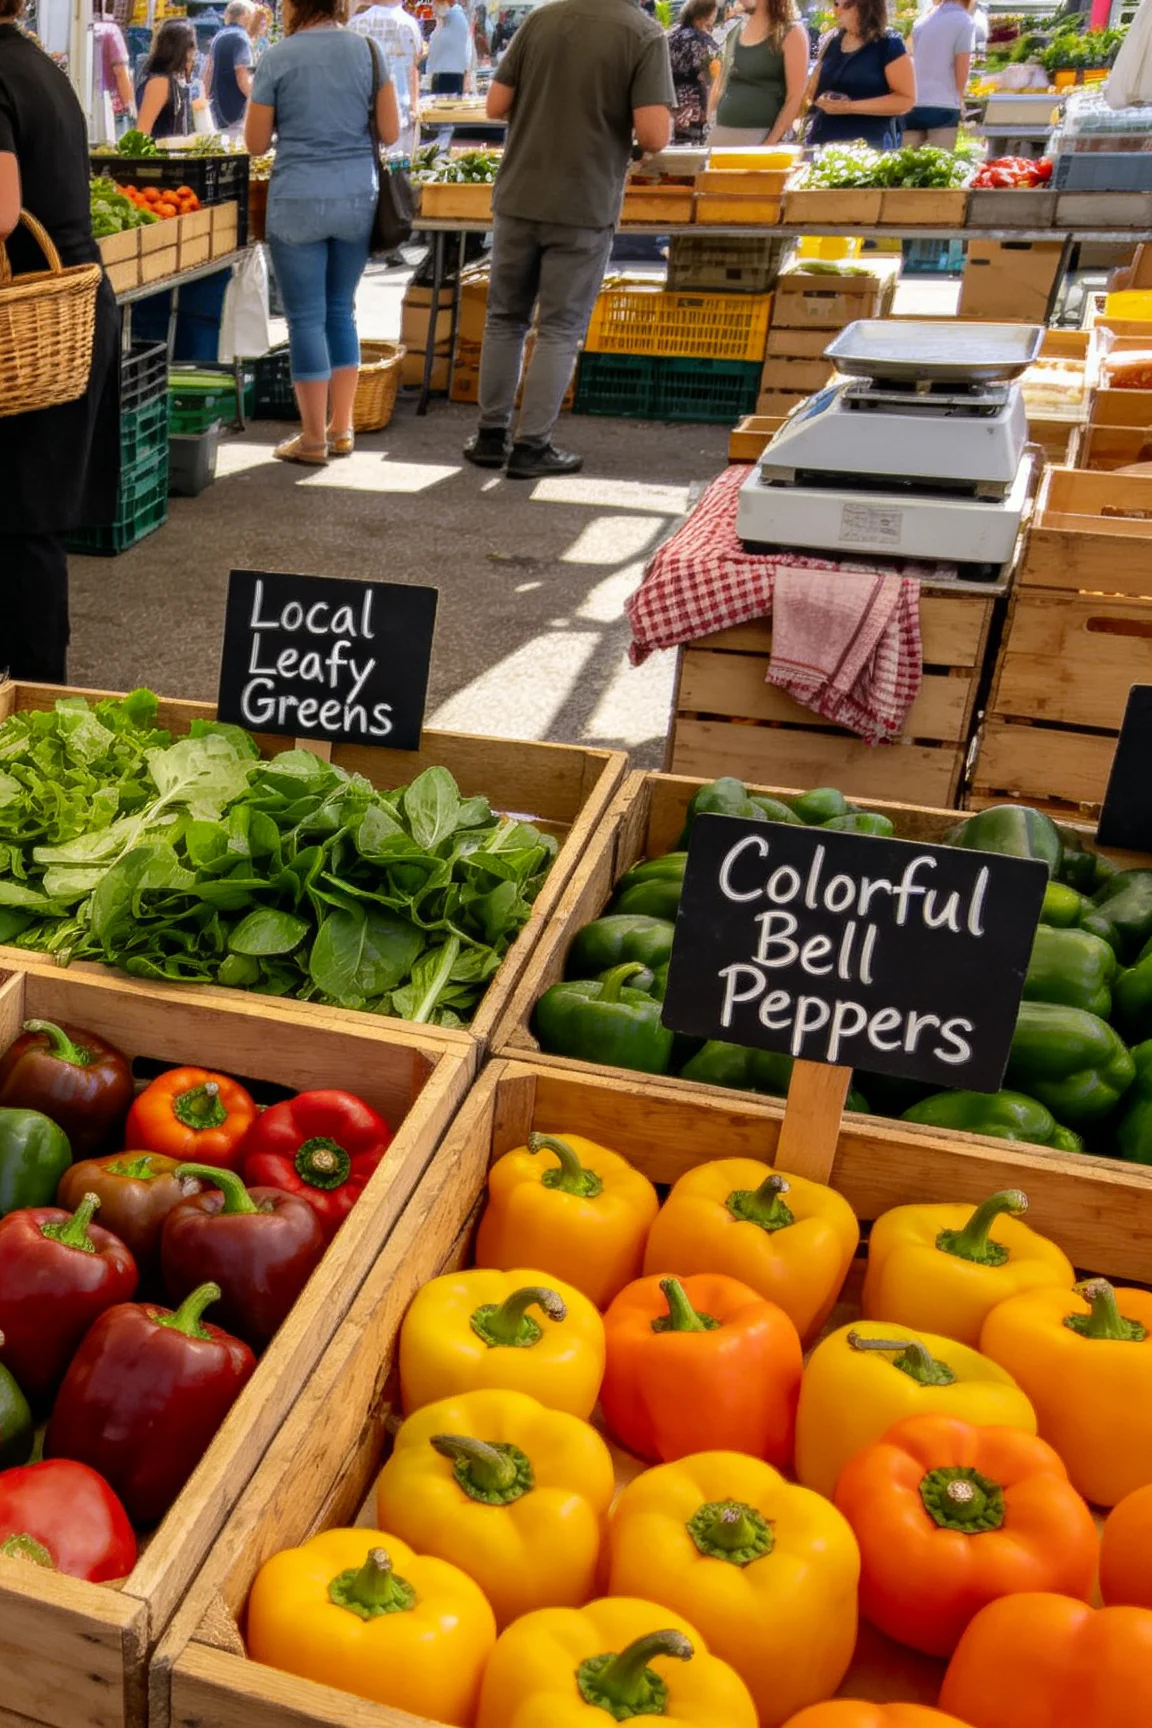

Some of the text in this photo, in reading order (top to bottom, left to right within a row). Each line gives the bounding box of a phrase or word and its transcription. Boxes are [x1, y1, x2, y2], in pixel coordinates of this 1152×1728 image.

[250, 579, 374, 640] Local
[249, 632, 376, 704] Leafy
[241, 678, 394, 735] Greens
[719, 836, 990, 937] Colorful
[752, 911, 877, 984] Bell
[718, 964, 974, 1064] Peppers
